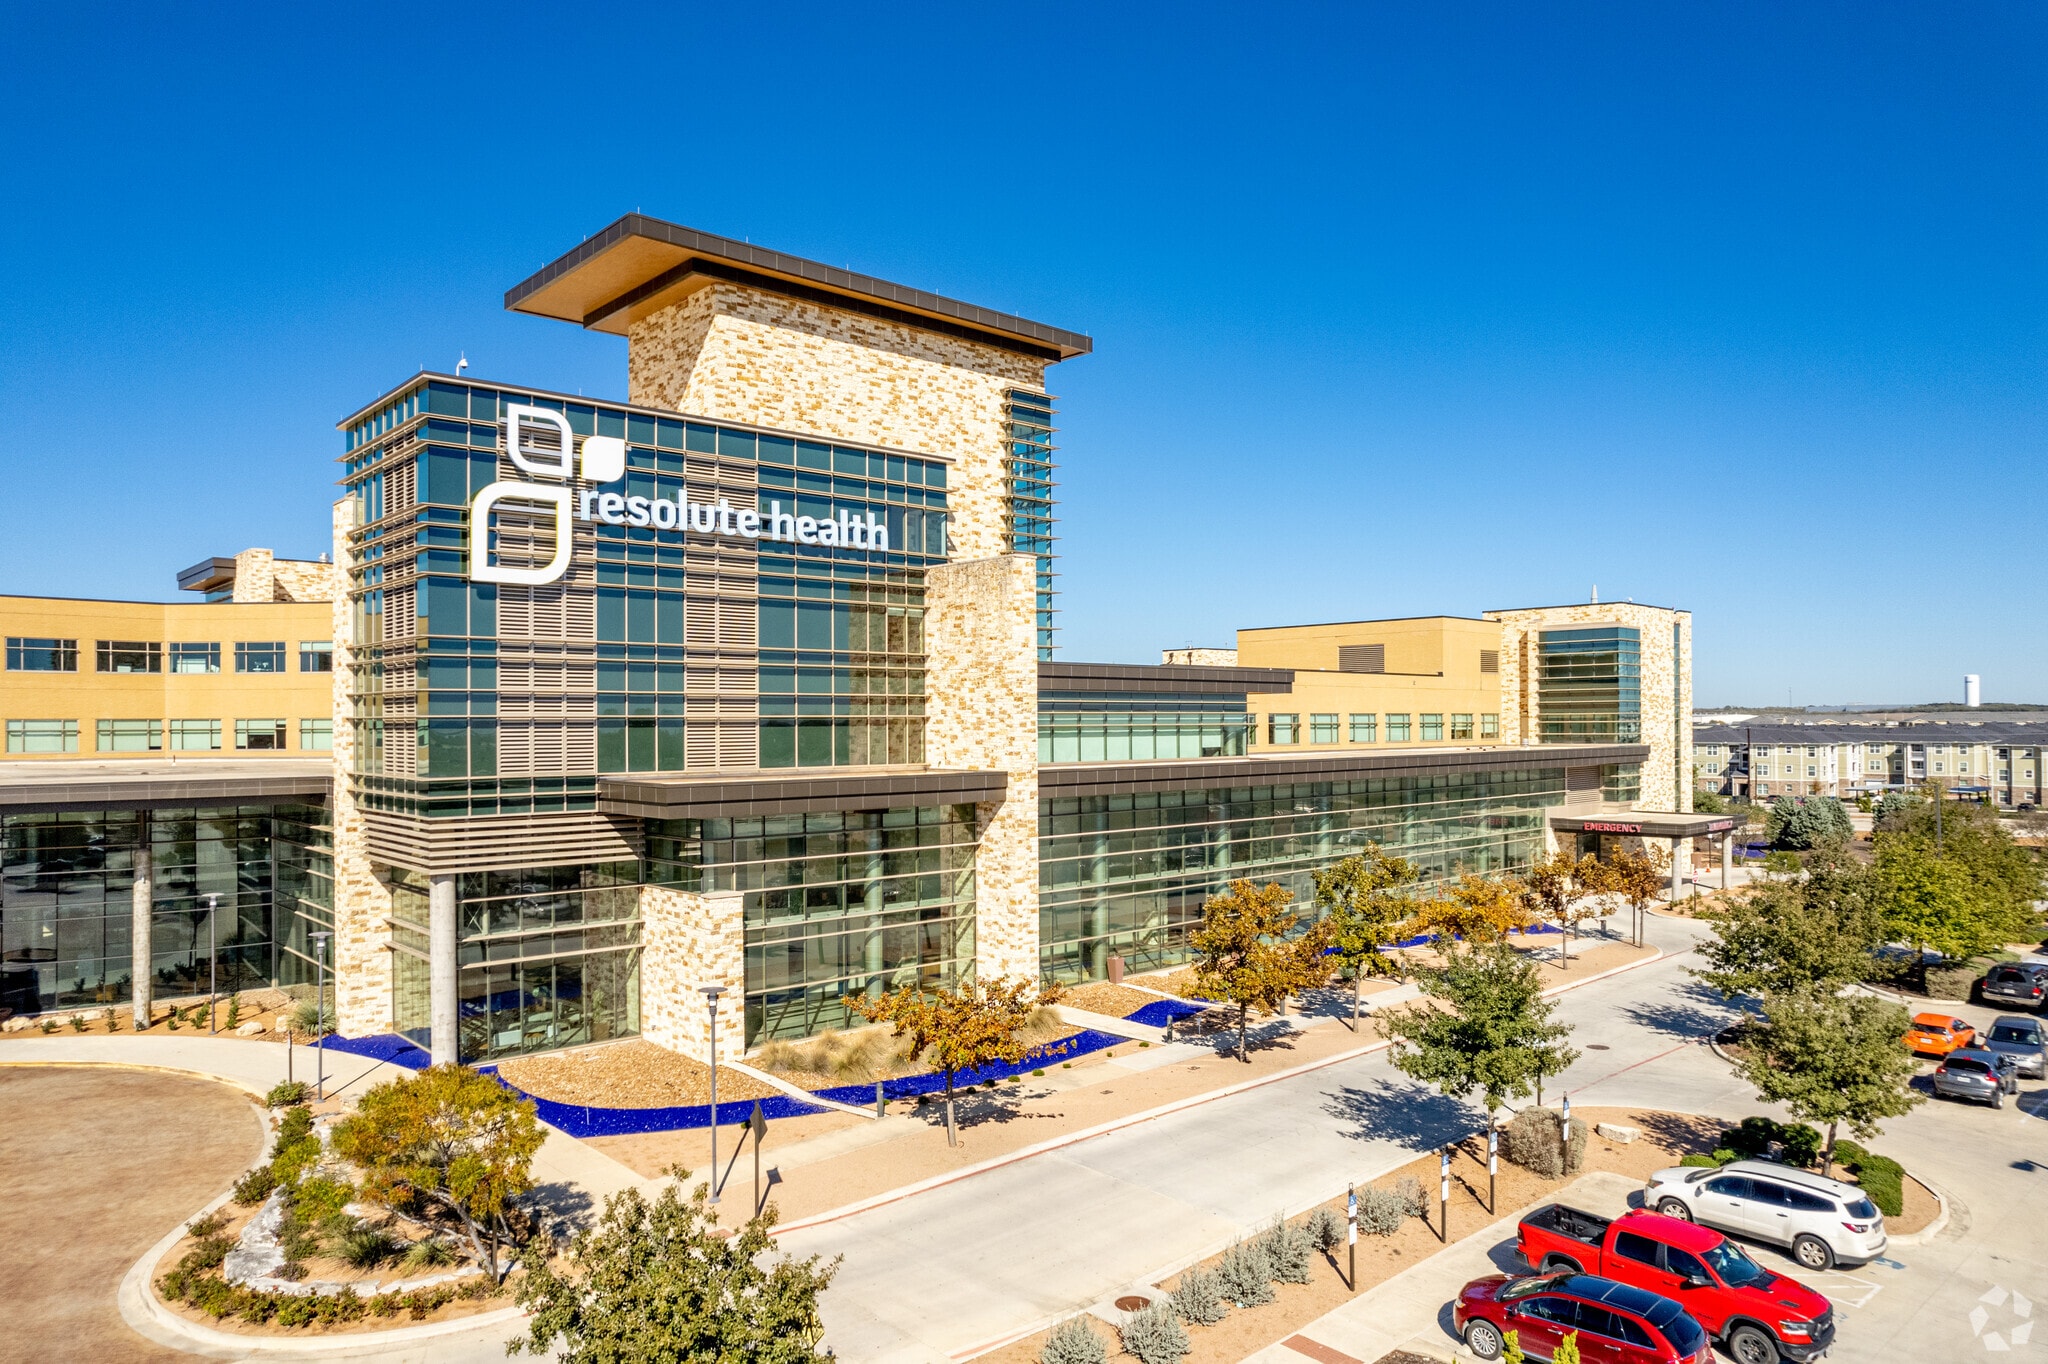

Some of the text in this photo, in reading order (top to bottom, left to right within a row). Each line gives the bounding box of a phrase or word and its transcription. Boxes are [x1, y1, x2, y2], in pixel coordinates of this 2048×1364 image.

[580, 489, 888, 551] resolute health
[1584, 822, 1642, 832] EMERGENCY
